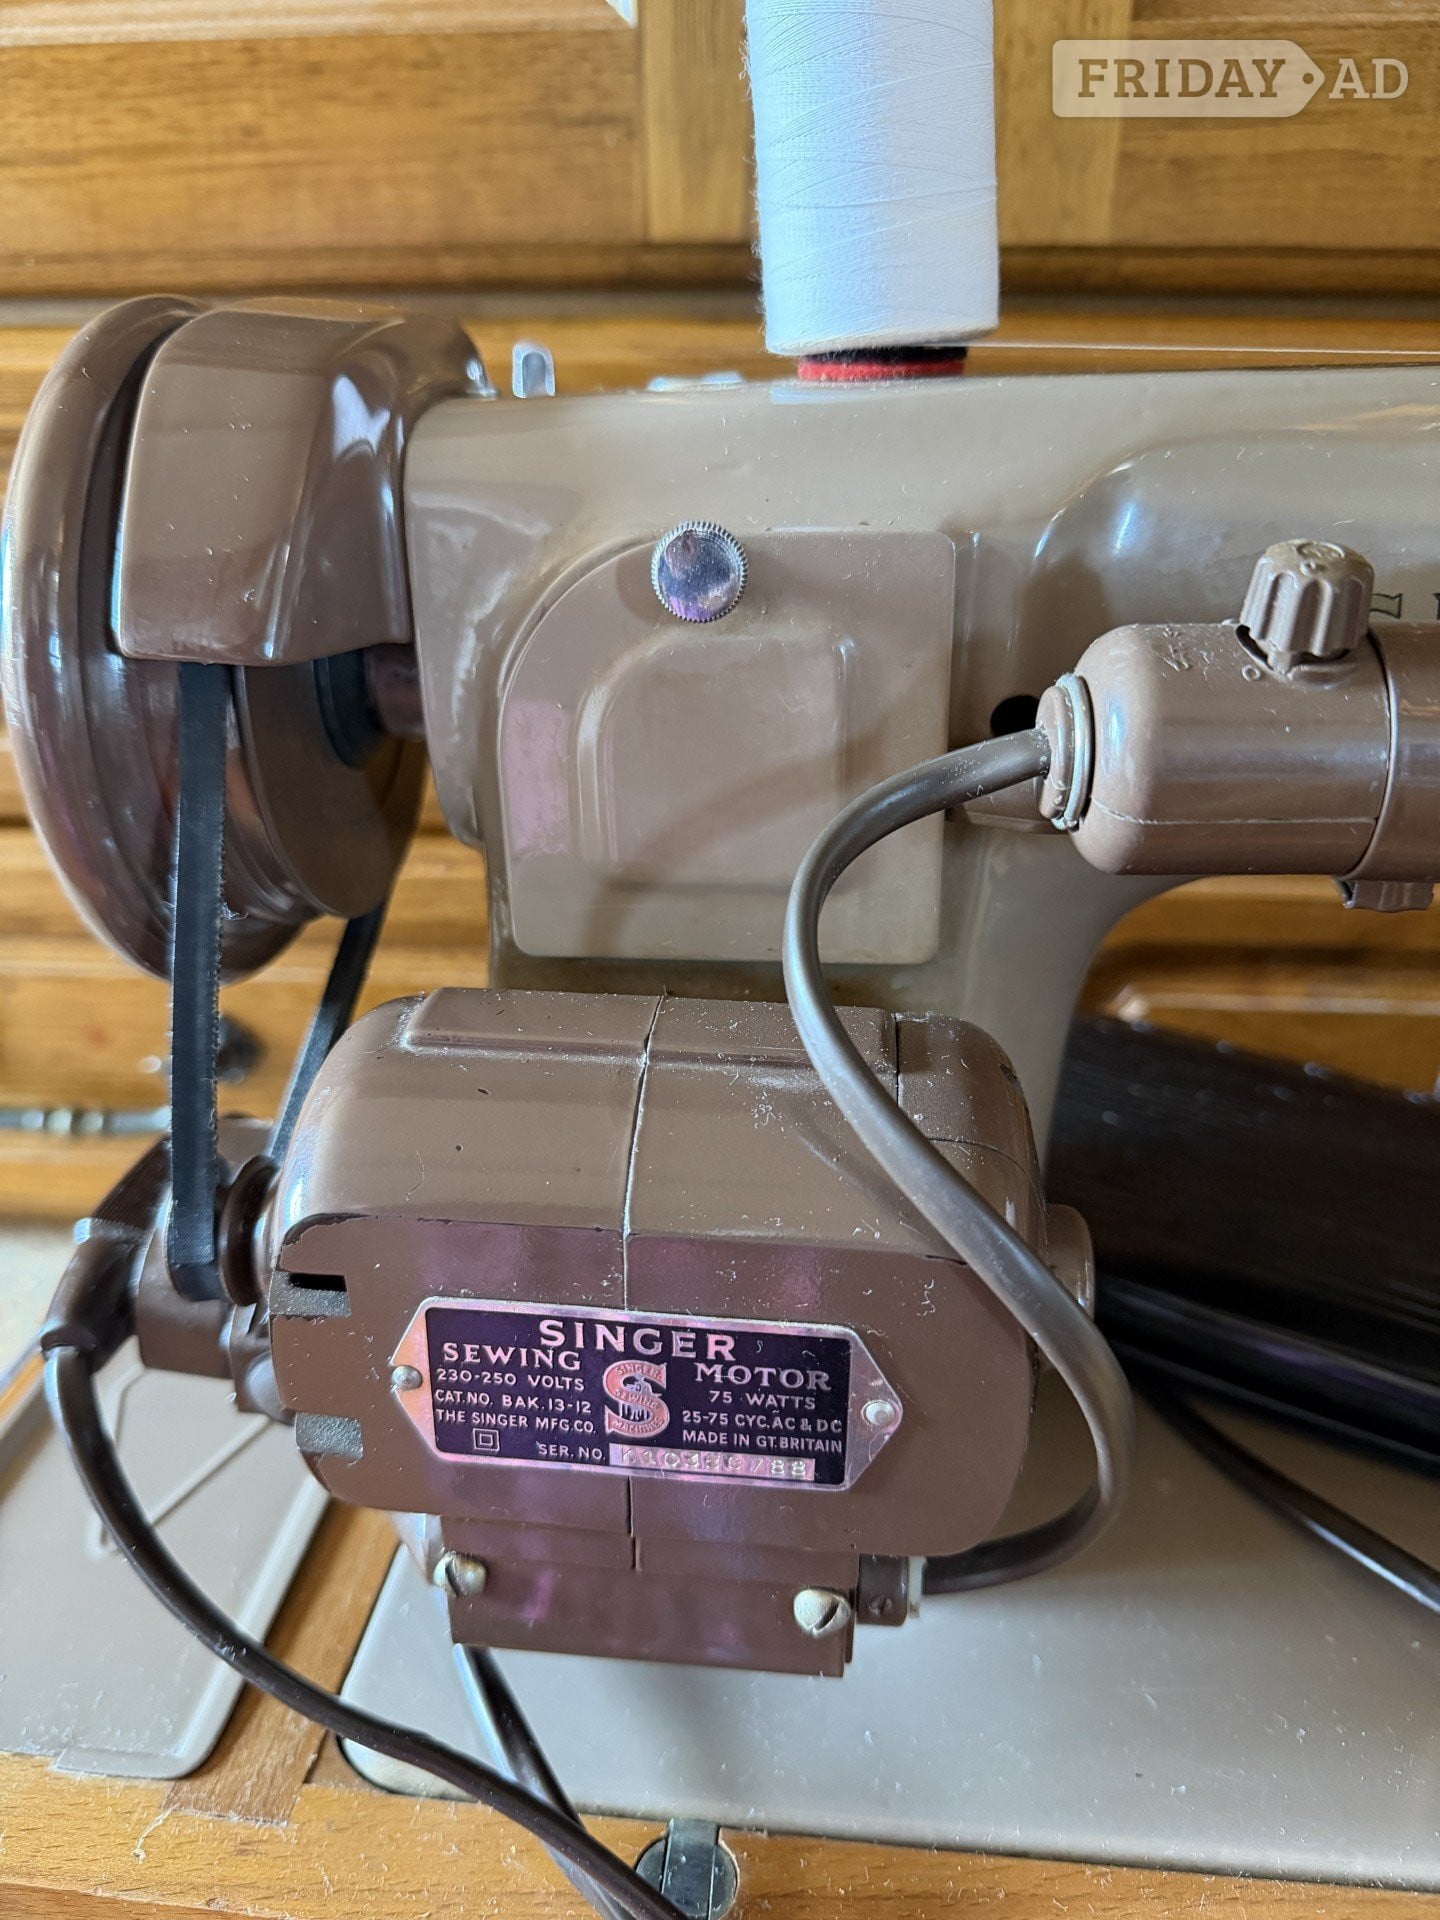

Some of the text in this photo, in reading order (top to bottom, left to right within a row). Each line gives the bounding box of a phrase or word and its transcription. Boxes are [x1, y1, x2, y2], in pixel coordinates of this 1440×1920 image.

[539, 1319, 736, 1361] SINGER
[443, 1342, 581, 1371] SEWING
[436, 1368, 585, 1391] 230-250 VOLTS
[693, 1362, 832, 1391] MOTOR
[708, 1390, 816, 1410] 75 WATTS
[435, 1408, 467, 1423] THE
[472, 1411, 529, 1427] SINGER
[682, 1410, 729, 1425] 25-75
[799, 1418, 812, 1432] &
[682, 1429, 729, 1445] MADE
[733, 1432, 750, 1447] IN
